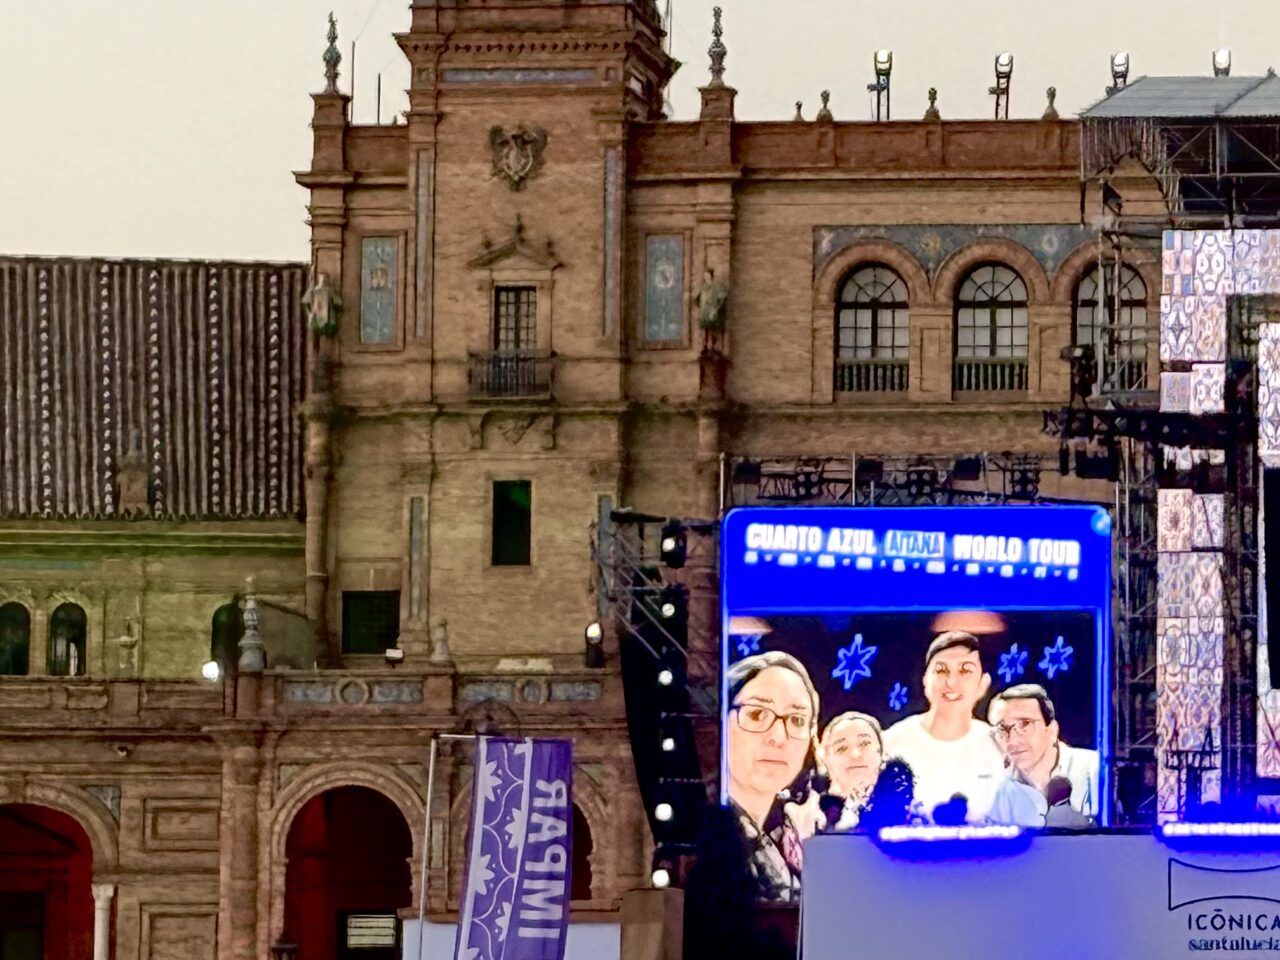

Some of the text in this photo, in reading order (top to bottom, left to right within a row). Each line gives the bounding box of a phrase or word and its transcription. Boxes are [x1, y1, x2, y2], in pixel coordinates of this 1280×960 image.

[746, 523, 822, 552] CUARTO
[827, 527, 877, 554] AZUL
[953, 534, 1022, 562] WORLD
[1028, 538, 1080, 566] TOUR
